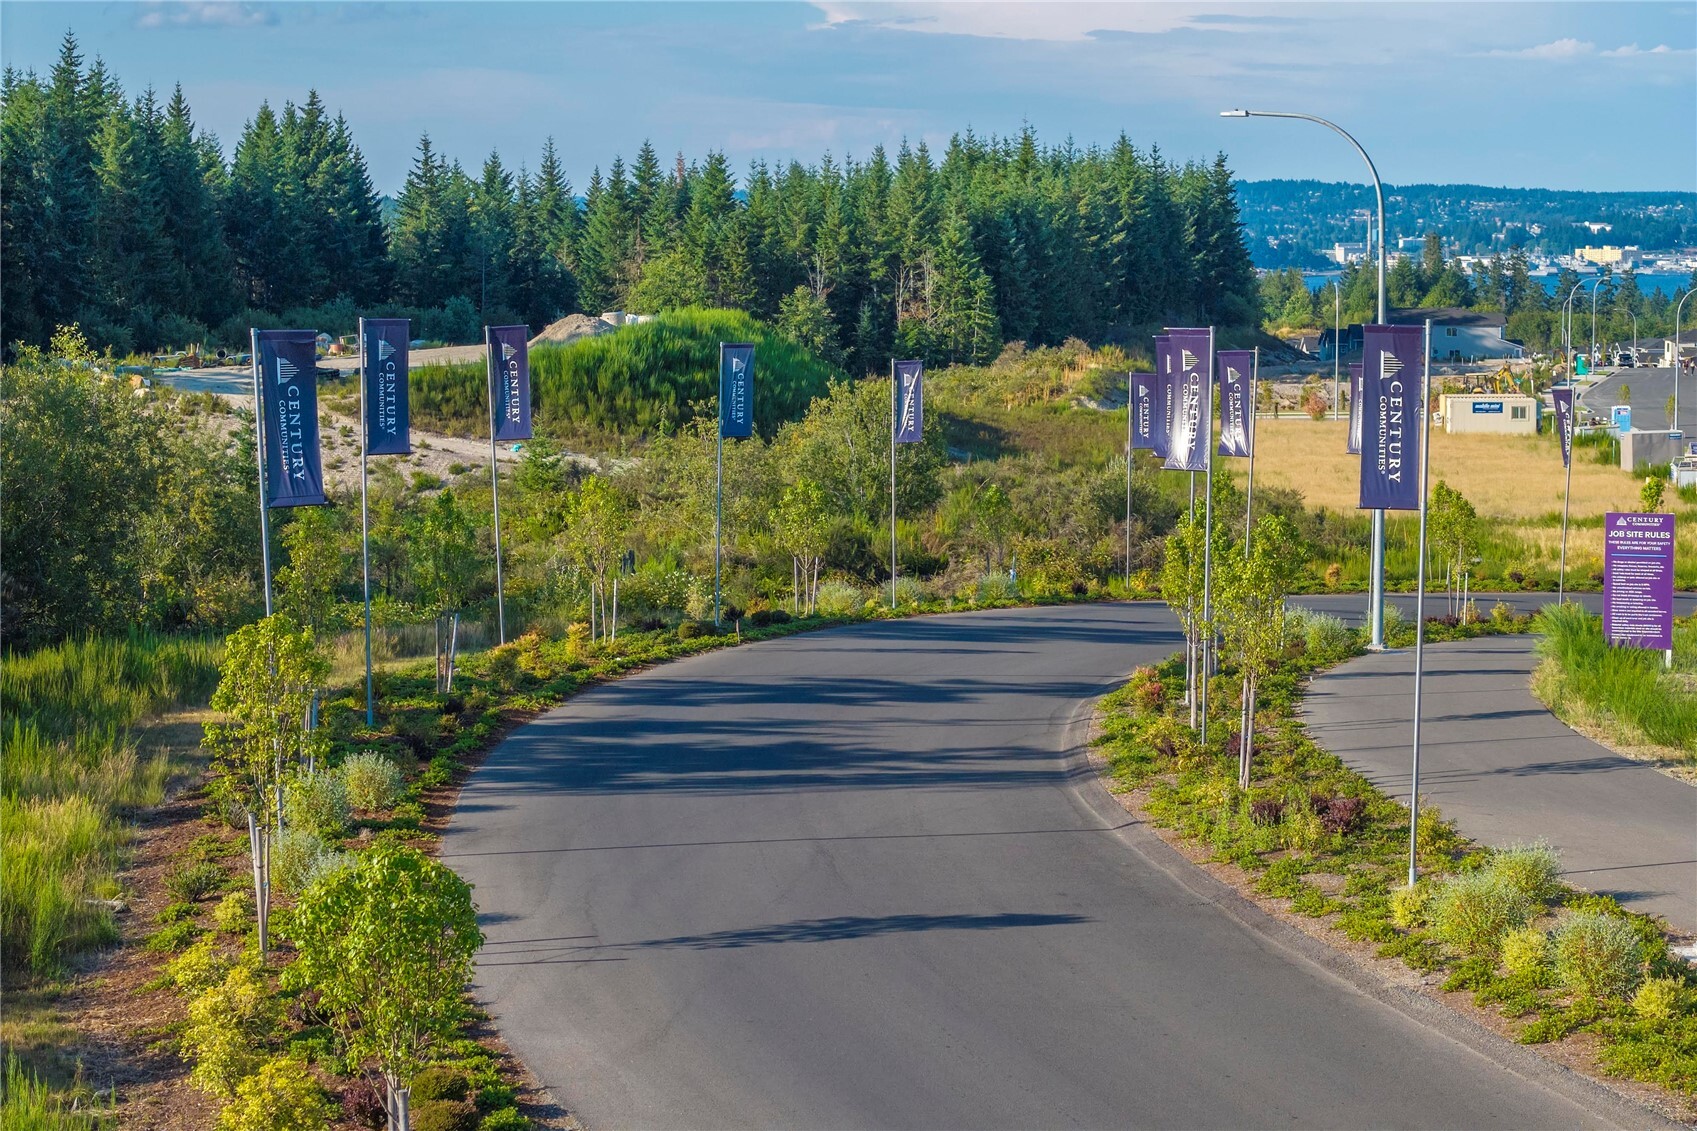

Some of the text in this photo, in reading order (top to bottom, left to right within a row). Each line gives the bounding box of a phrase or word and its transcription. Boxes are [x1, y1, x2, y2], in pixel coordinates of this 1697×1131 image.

[378, 372, 386, 429] COMMUNITIES
[385, 361, 397, 436] CENTURY
[509, 360, 521, 424] CENTURY
[736, 373, 745, 425] CENTURY
[907, 387, 915, 432] ENTURY
[1188, 372, 1200, 450] CENTURY
[278, 400, 290, 473] COMMUNITIES
[287, 385, 306, 481] CENTURY
[1378, 395, 1388, 474] COMMUNITIES
[1388, 381, 1403, 483] CENTURY
[1608, 530, 1625, 538] JOB
[1645, 531, 1671, 539] RULES
